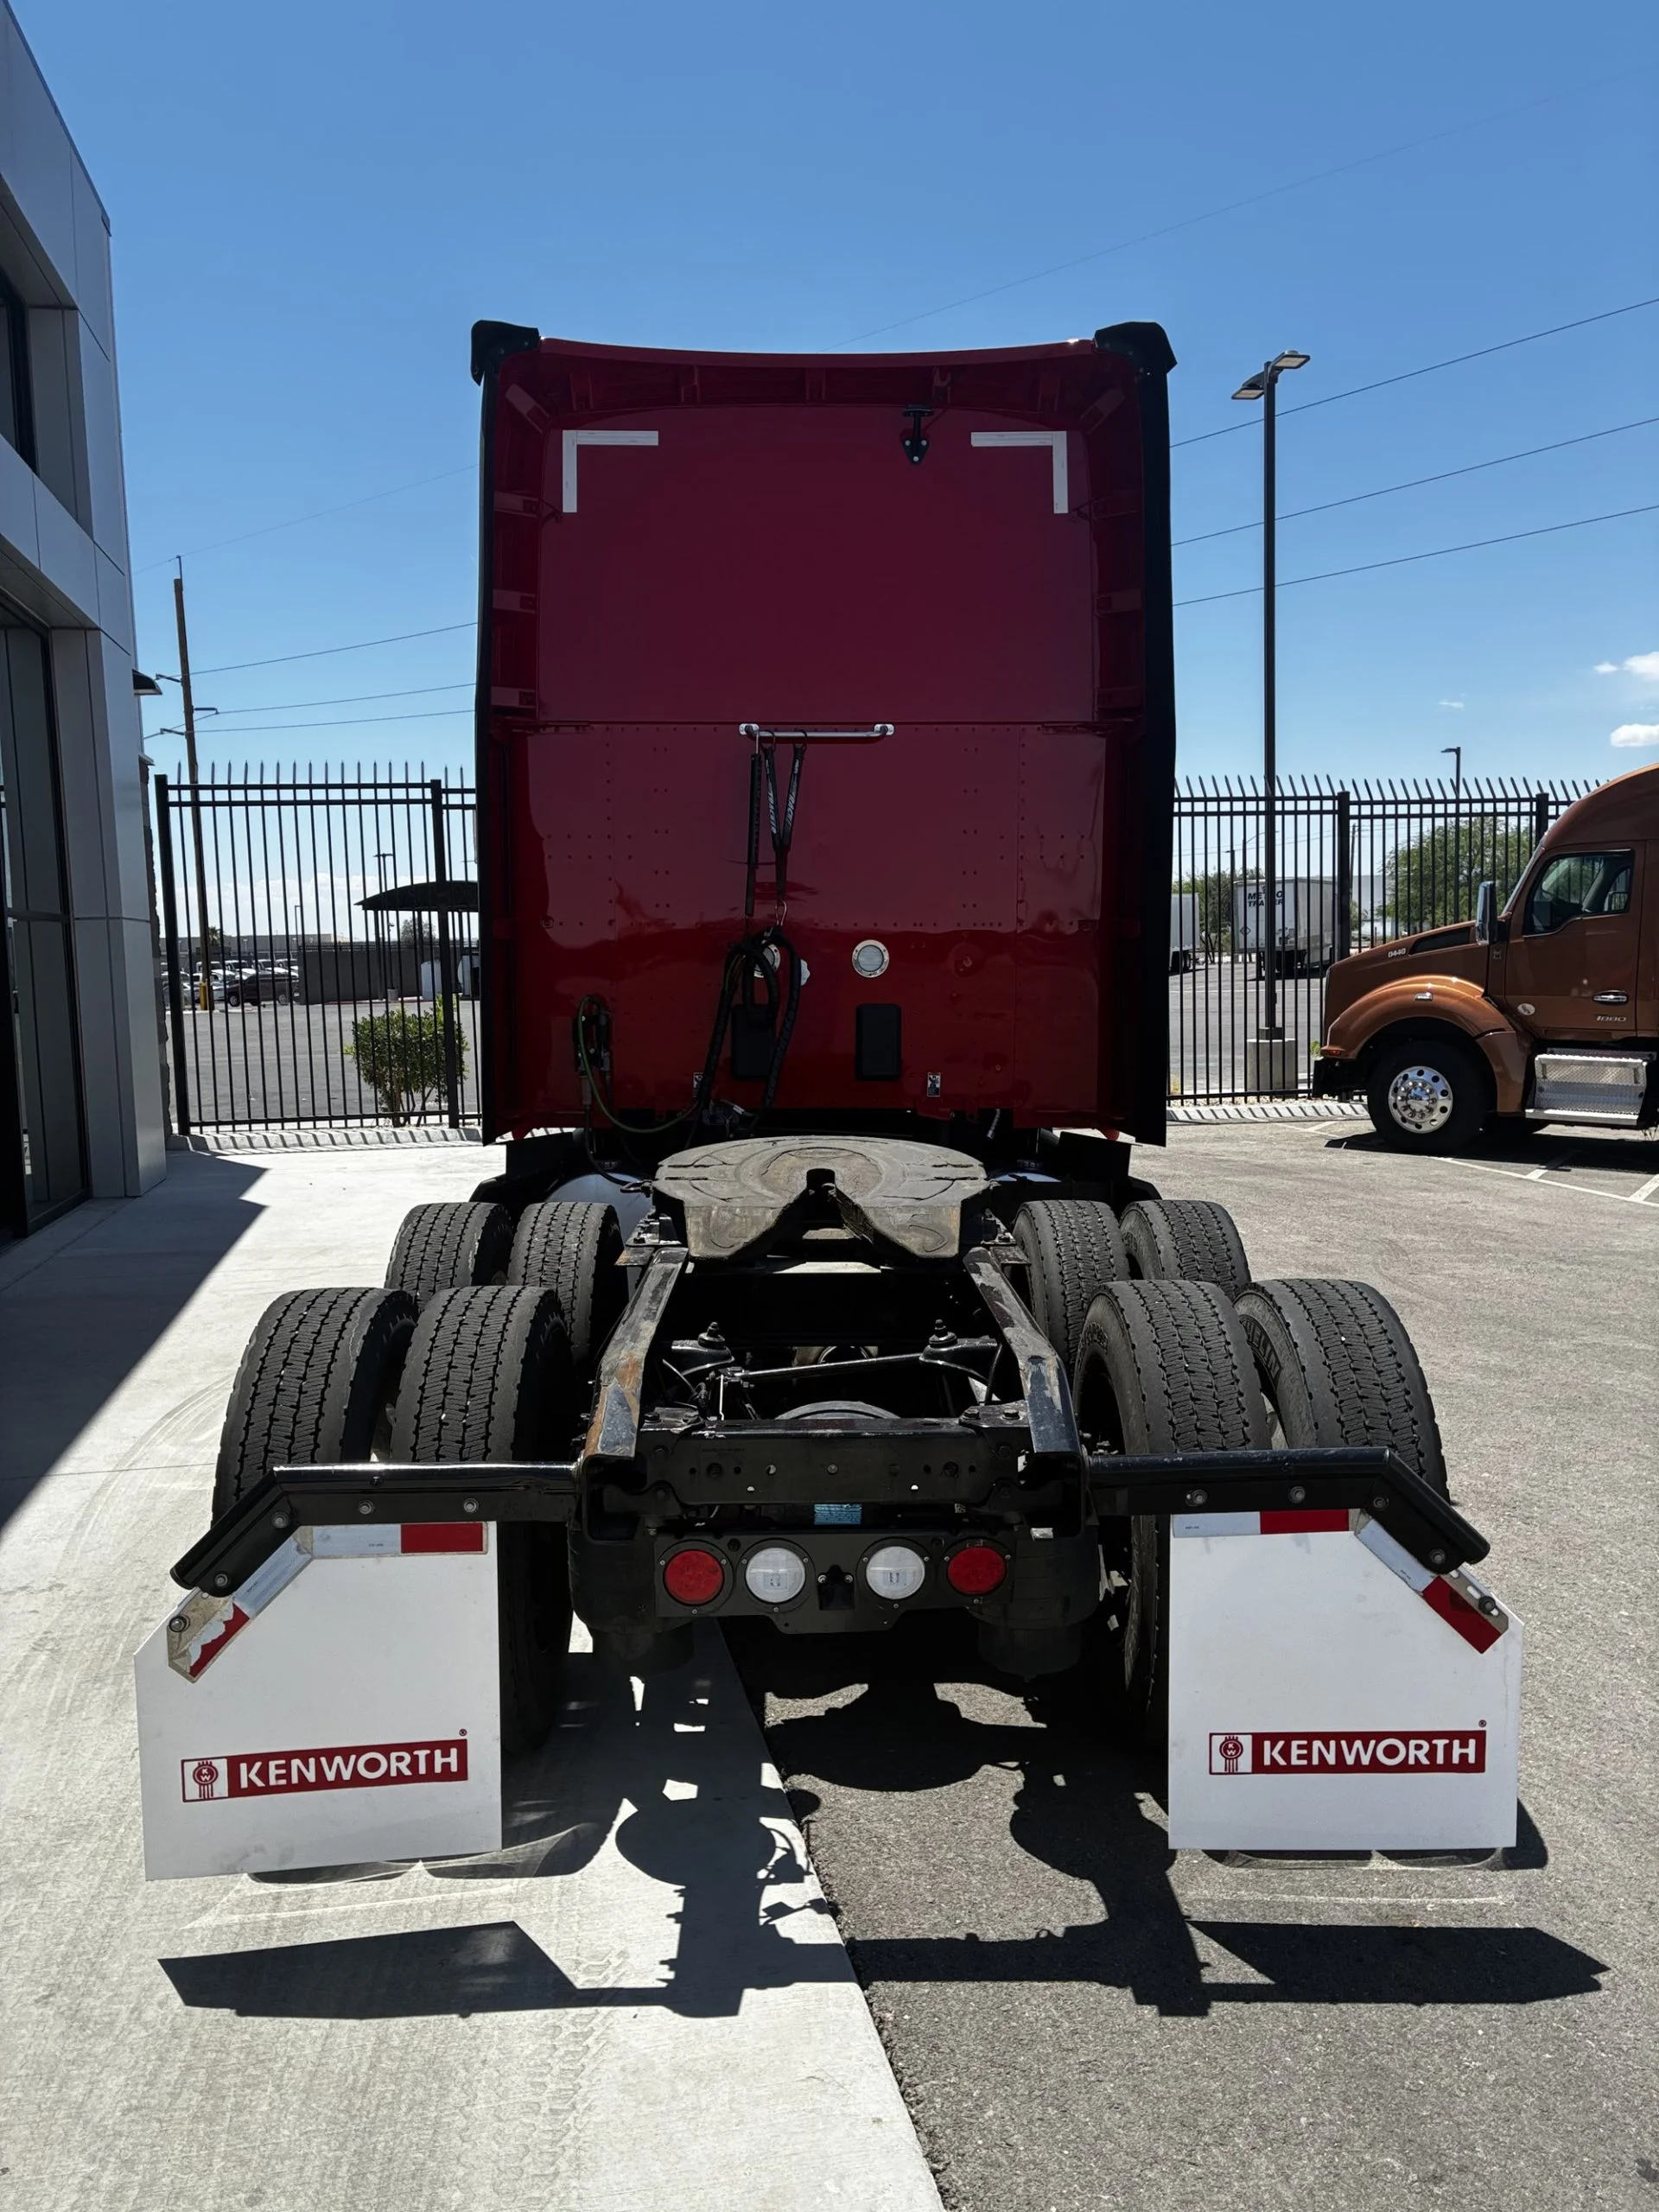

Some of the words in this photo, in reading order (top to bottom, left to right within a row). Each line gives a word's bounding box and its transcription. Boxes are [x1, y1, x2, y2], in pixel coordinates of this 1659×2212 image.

[1248, 891, 1284, 900] MEO
[1262, 1738, 1476, 1766] KENWORTH
[239, 1747, 458, 1789] KENWORTH
